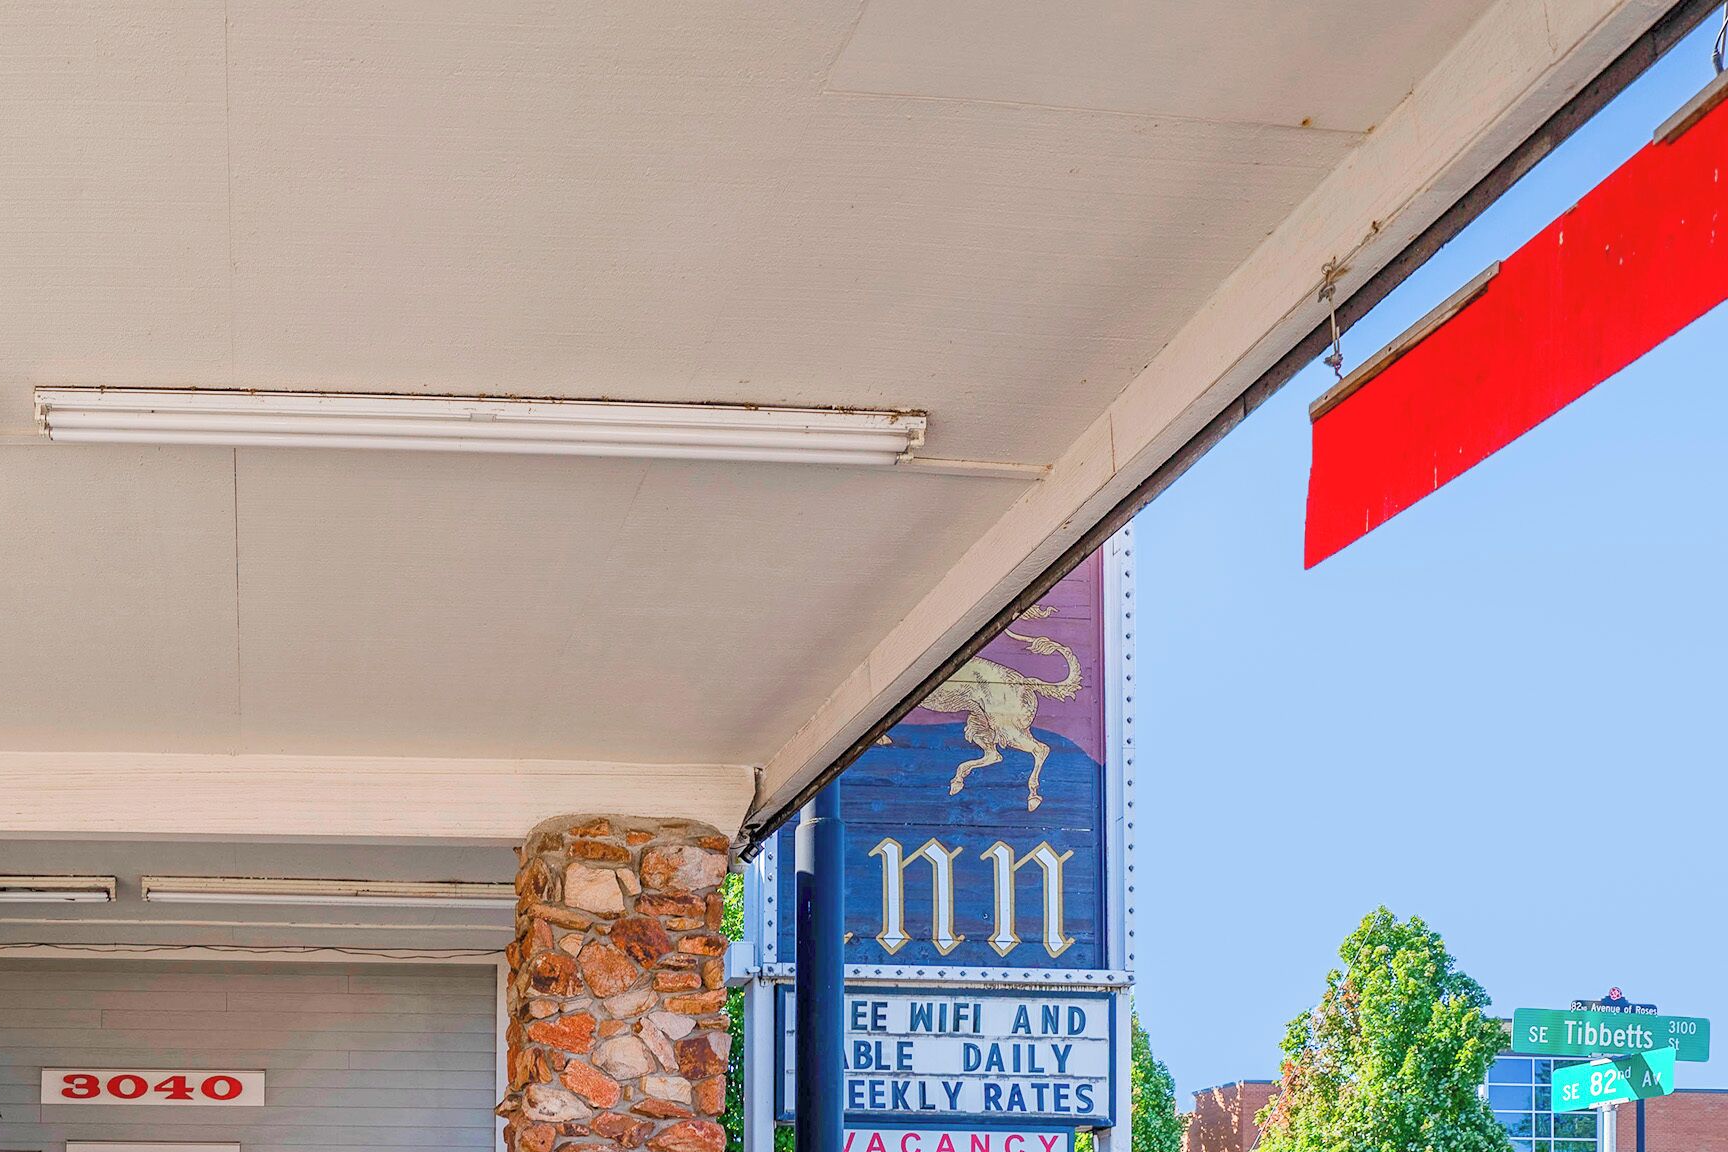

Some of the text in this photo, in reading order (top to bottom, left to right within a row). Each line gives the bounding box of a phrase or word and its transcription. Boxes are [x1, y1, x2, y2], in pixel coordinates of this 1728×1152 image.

[844, 837, 1076, 959] nn
[909, 1002, 982, 1033] WIFI
[1011, 1004, 1087, 1036] AND
[1591, 1003, 1620, 1014] Avenue
[1624, 1006, 1632, 1014] of
[1635, 1006, 1657, 1015] Roses
[1528, 1021, 1653, 1049] SE Tibbetts
[1668, 1020, 1697, 1035] 3100
[963, 1042, 1073, 1073] DAILY
[61, 1073, 243, 1100] 3040
[984, 1082, 1095, 1113] RATES
[1562, 1083, 1580, 1101] SE
[1641, 1070, 1661, 1088] Av
